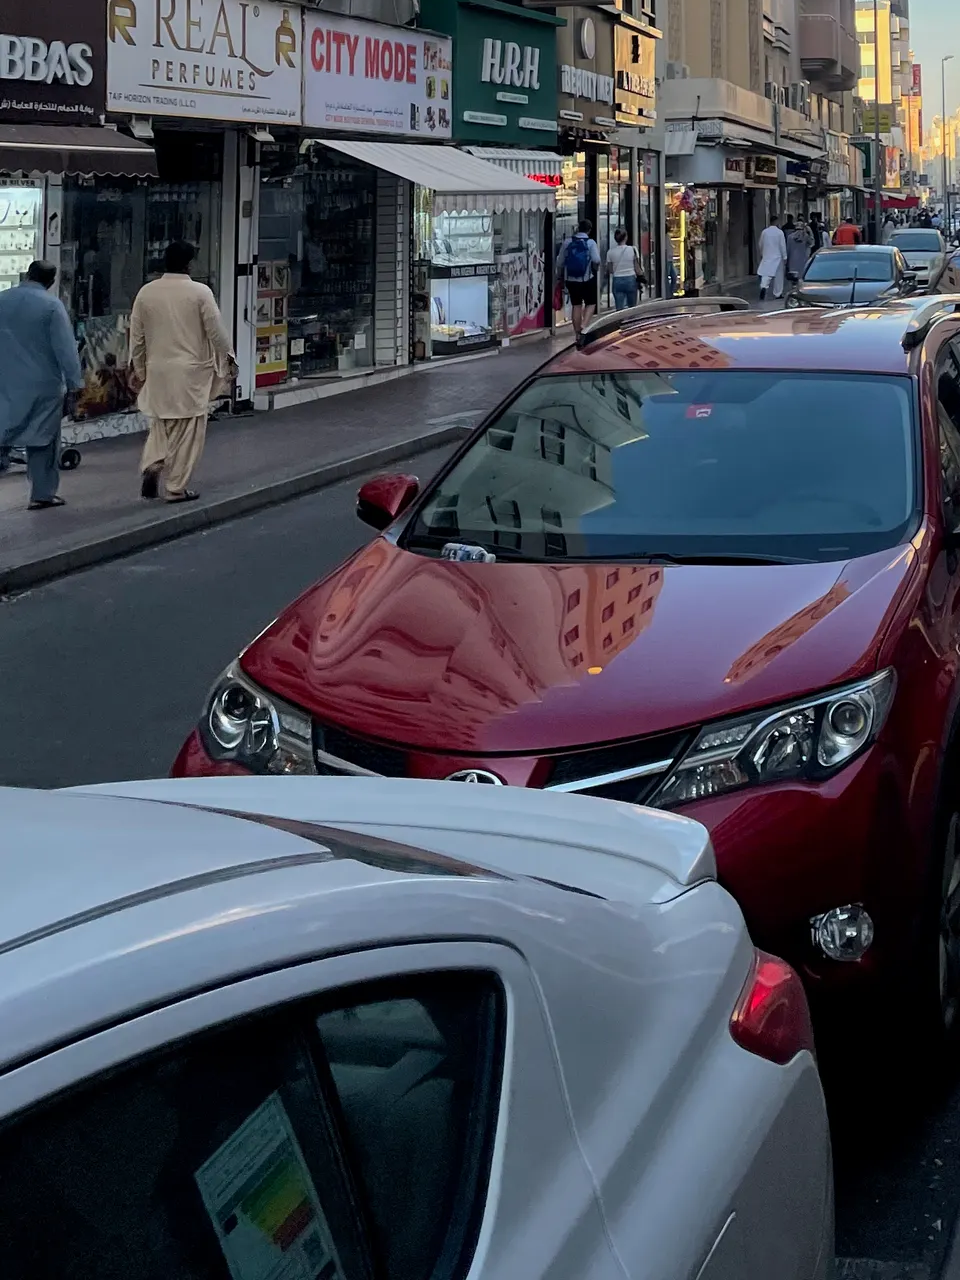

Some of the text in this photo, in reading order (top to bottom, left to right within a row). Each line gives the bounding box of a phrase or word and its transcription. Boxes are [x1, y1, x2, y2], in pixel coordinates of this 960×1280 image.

[310, 27, 417, 84] CITY MODE
[481, 37, 540, 90] HRH
[151, 59, 257, 91] PERFUMES
[12, 99, 33, 109] العامة
[34, 101, 57, 111] للتجارة
[108, 91, 122, 101] TAIF
[123, 93, 152, 104] HORIZON
[152, 96, 177, 106] TRADING
